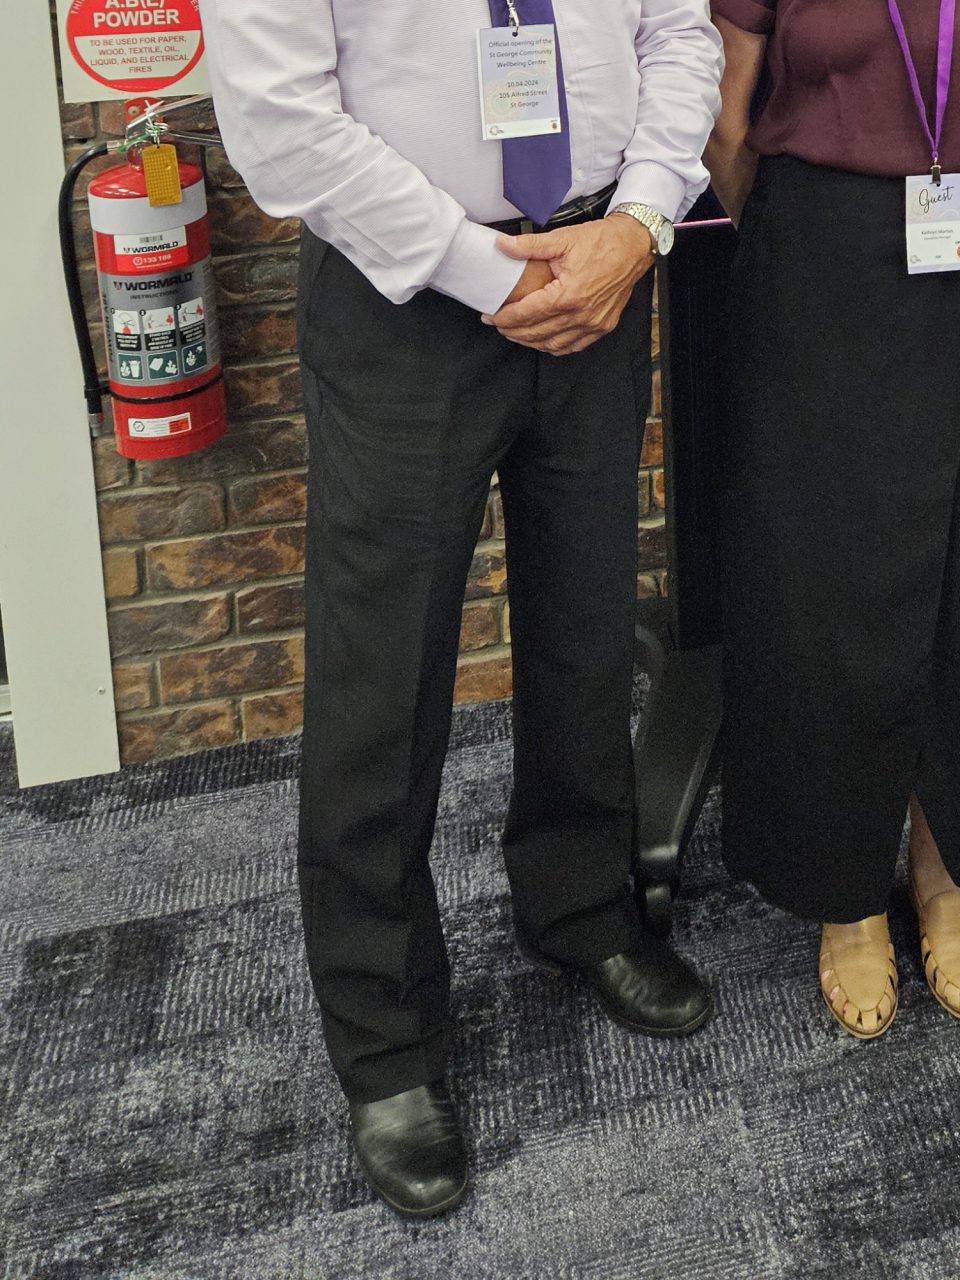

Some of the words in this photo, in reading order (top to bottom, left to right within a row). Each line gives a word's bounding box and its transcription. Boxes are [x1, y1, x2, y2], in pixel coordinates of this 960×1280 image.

[93, 9, 180, 28] POWDER
[90, 39, 101, 47] TO
[103, 38, 114, 46] BE
[116, 37, 138, 45] USED
[139, 36, 158, 44] FOR
[158, 35, 186, 43] PAPER,
[98, 48, 126, 56] WOOD,
[129, 46, 162, 54] TEXTILE,
[90, 58, 119, 66] LIQUID,
[140, 54, 189, 63] ELECTRICAL
[129, 65, 152, 73] FIRES
[918, 186, 955, 214] Guest
[132, 241, 179, 253] WORMALD
[125, 272, 193, 291] WORMALD
